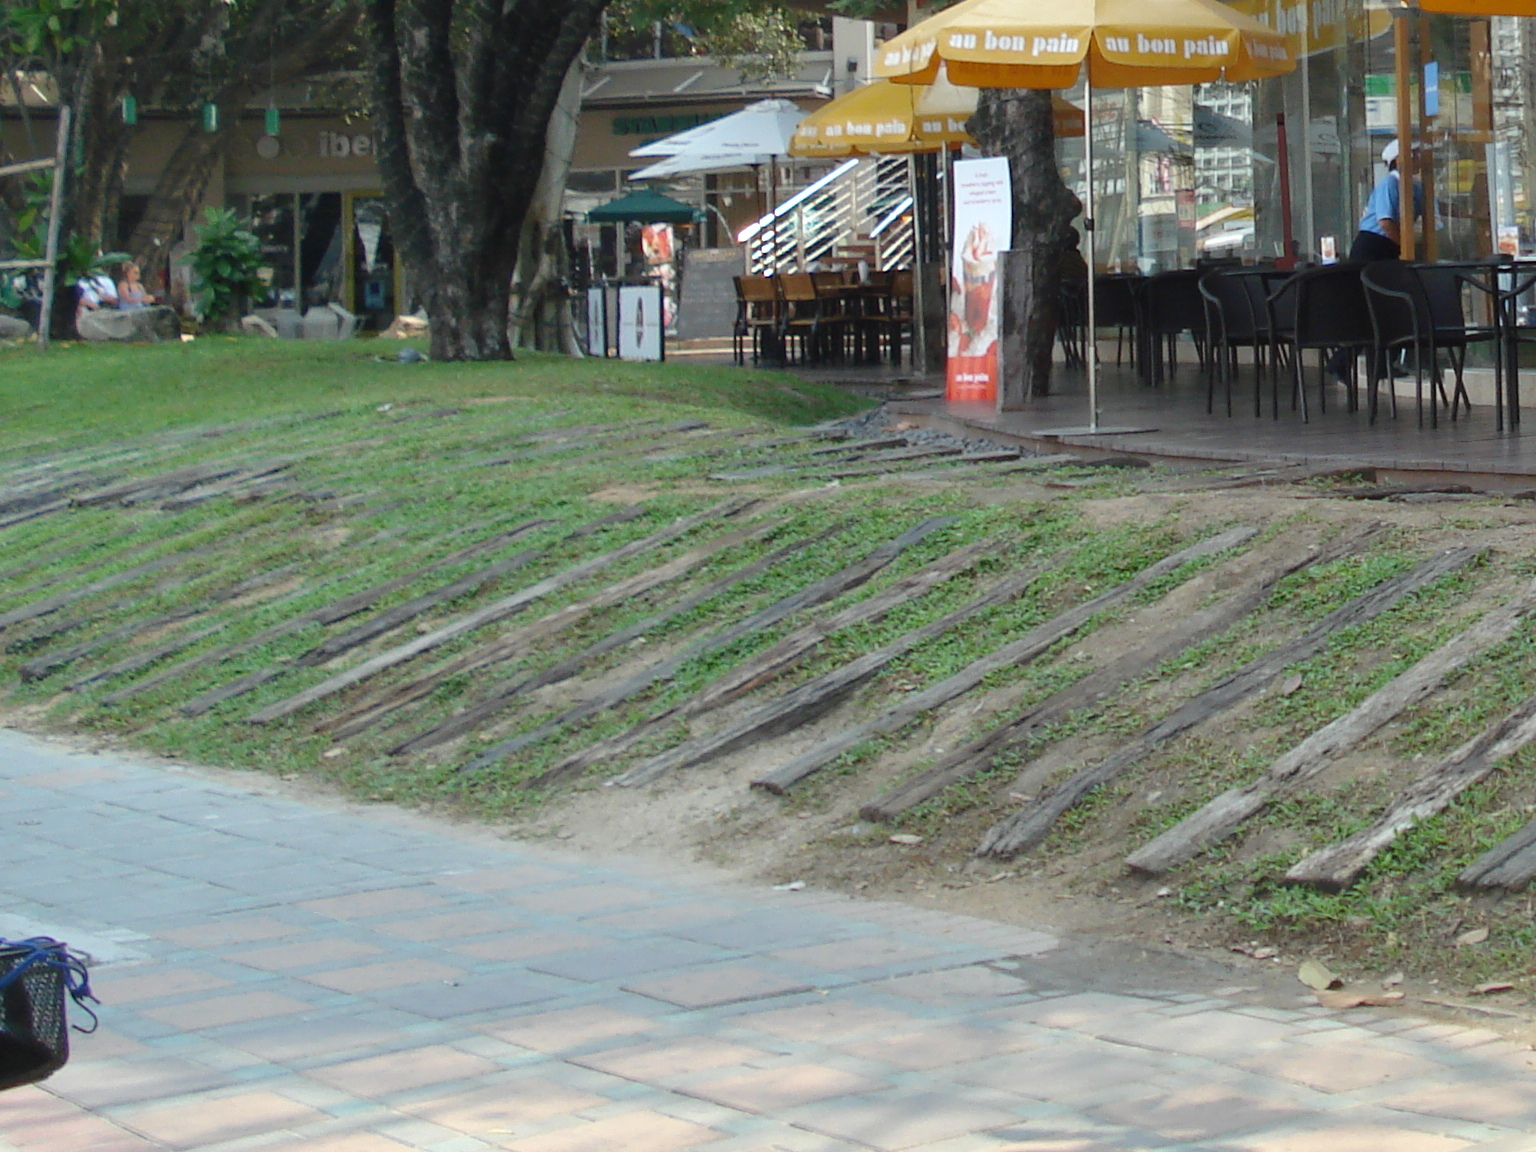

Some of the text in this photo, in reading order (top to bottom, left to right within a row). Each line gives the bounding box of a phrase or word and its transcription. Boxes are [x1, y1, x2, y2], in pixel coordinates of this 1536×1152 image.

[949, 29, 1079, 58] au bon pain
[1104, 33, 1229, 60] au bon pain
[847, 120, 872, 135] bon
[875, 118, 906, 137] pain
[947, 117, 965, 133] bo
